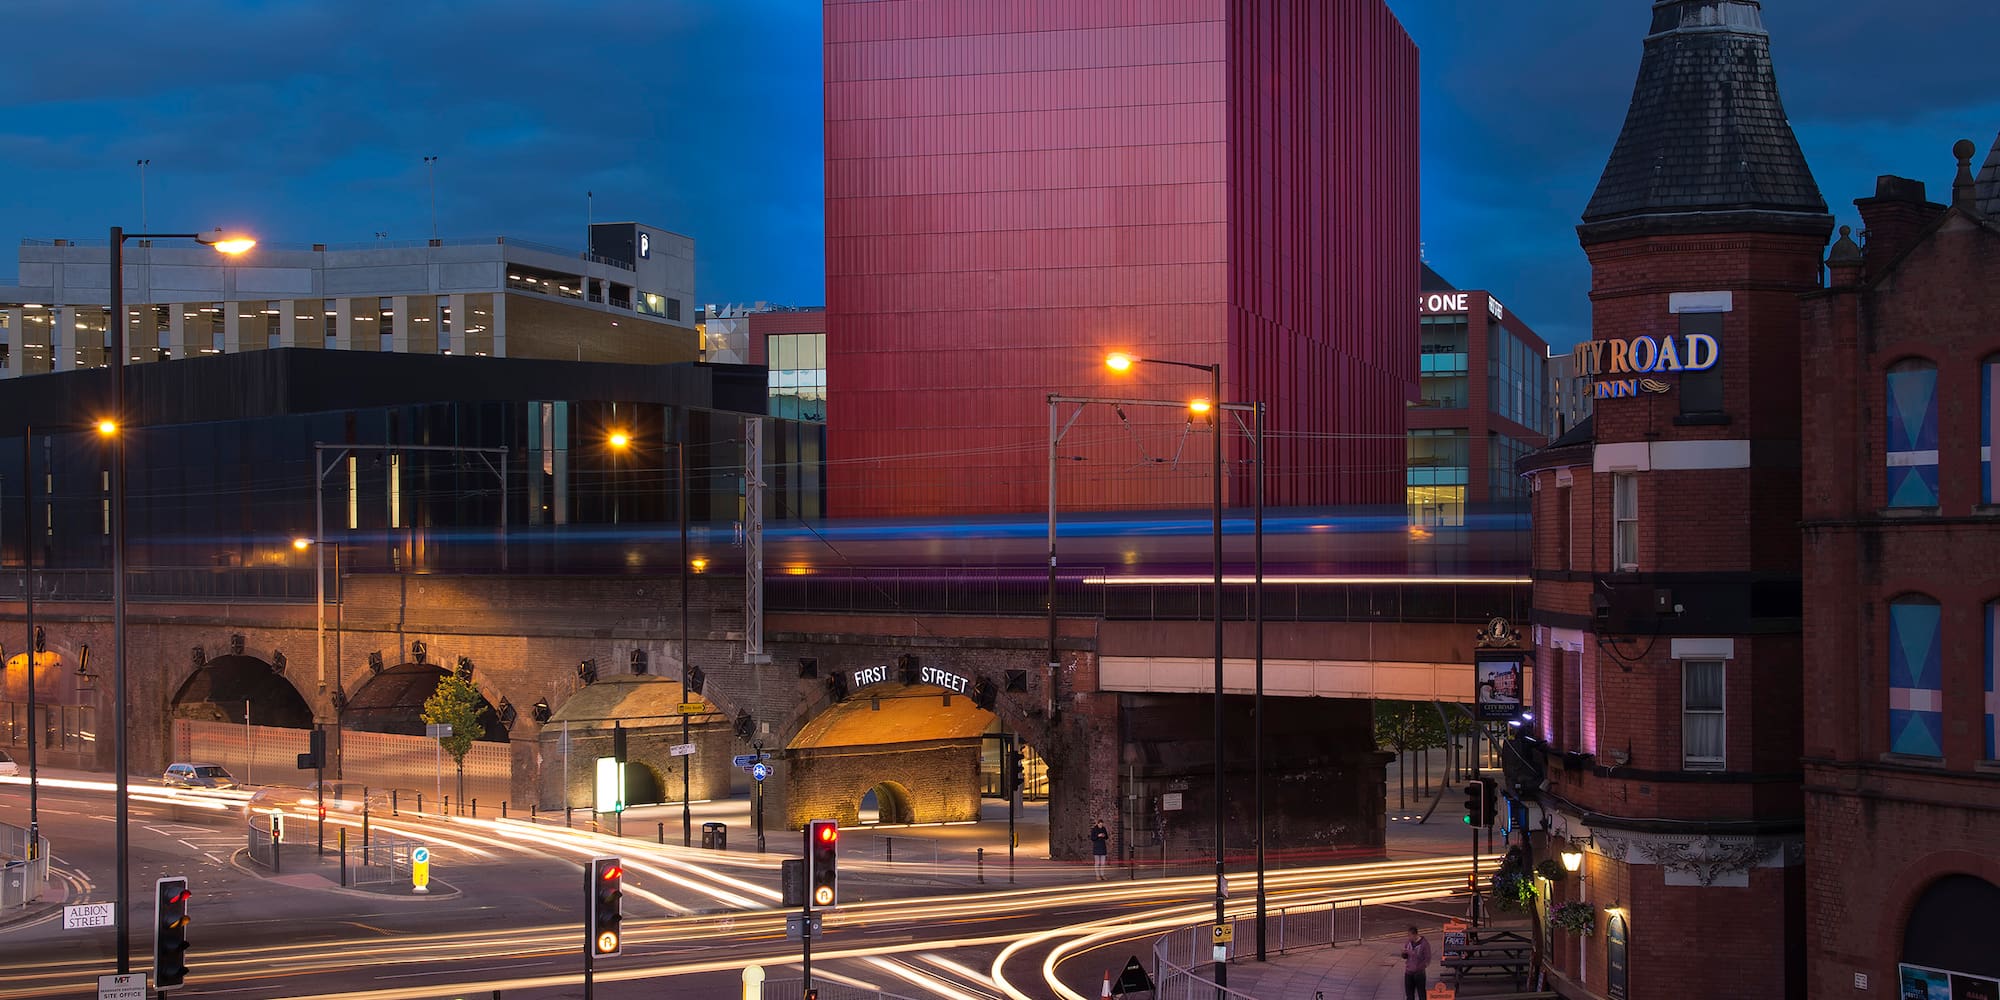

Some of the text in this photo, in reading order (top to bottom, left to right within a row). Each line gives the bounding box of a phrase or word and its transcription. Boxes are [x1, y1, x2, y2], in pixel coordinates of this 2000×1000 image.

[1428, 293, 1469, 312] ONE
[1608, 333, 1719, 374] ROAD
[1593, 378, 1638, 400] INN
[854, 665, 969, 693] FIRST STREET
[70, 905, 108, 917] ALBION
[69, 915, 108, 928] STREET
[114, 976, 131, 984] MPT
